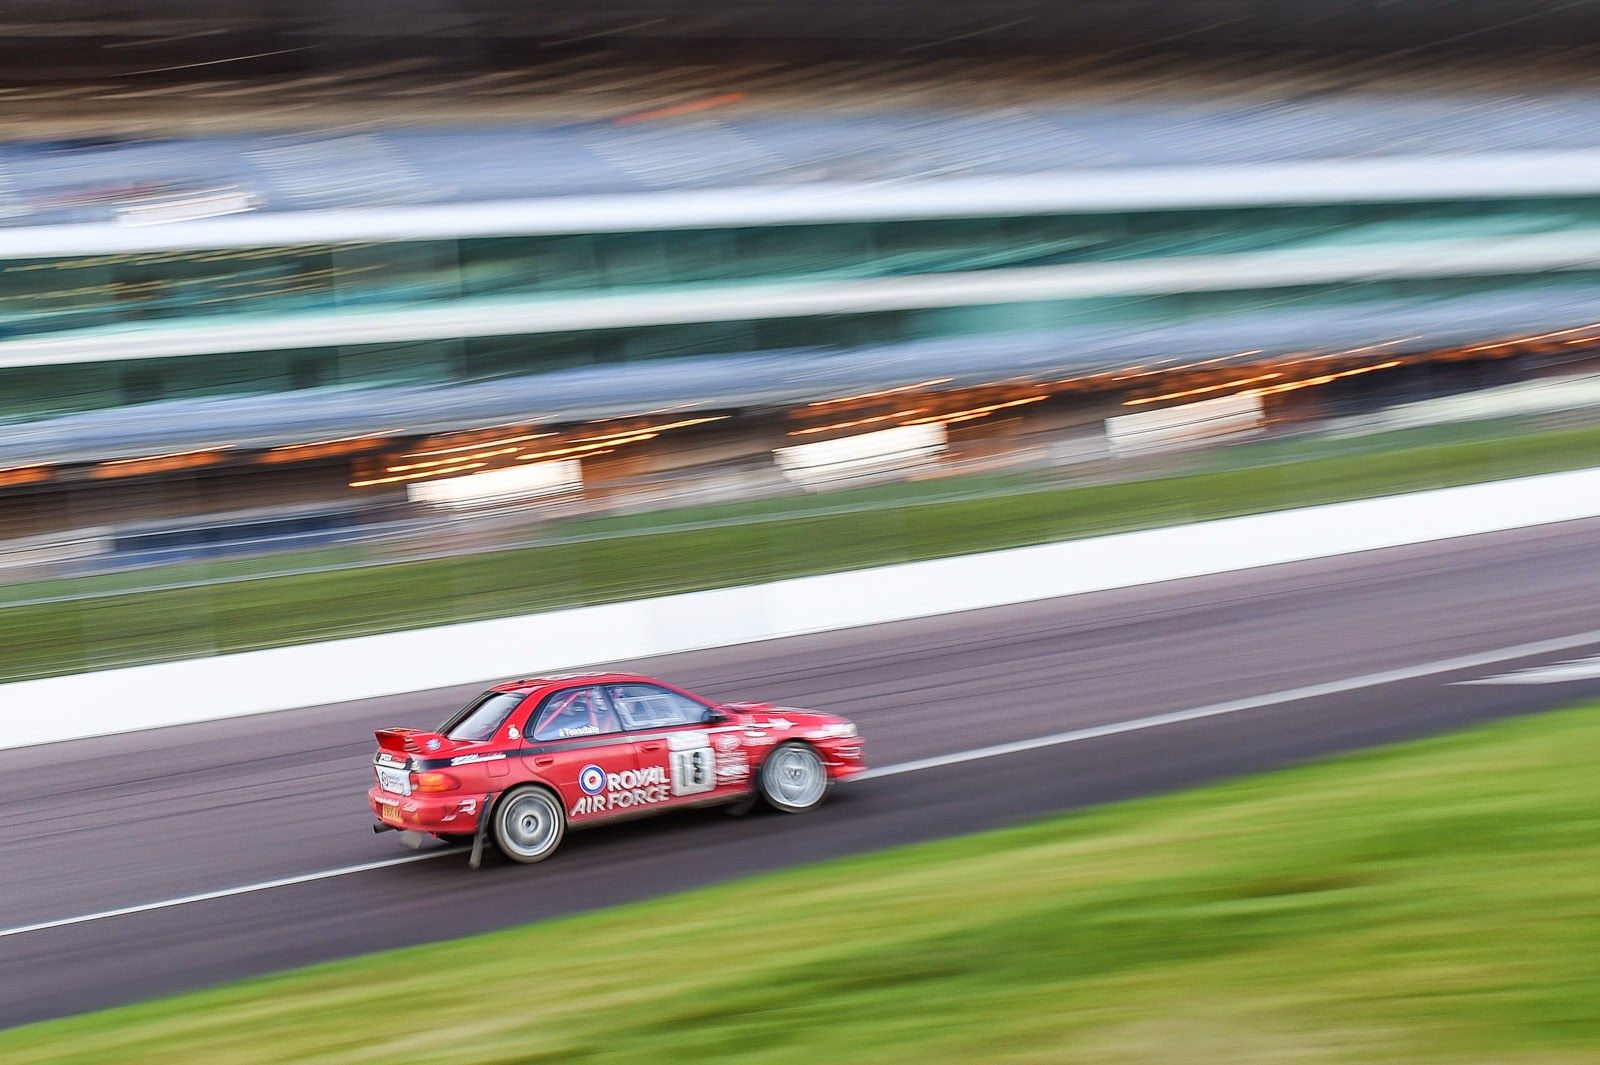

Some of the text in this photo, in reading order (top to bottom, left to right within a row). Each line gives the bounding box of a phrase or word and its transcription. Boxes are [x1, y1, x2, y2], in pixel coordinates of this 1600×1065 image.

[606, 765, 671, 792] ROYAL
[570, 784, 671, 817] AIR FORCE
